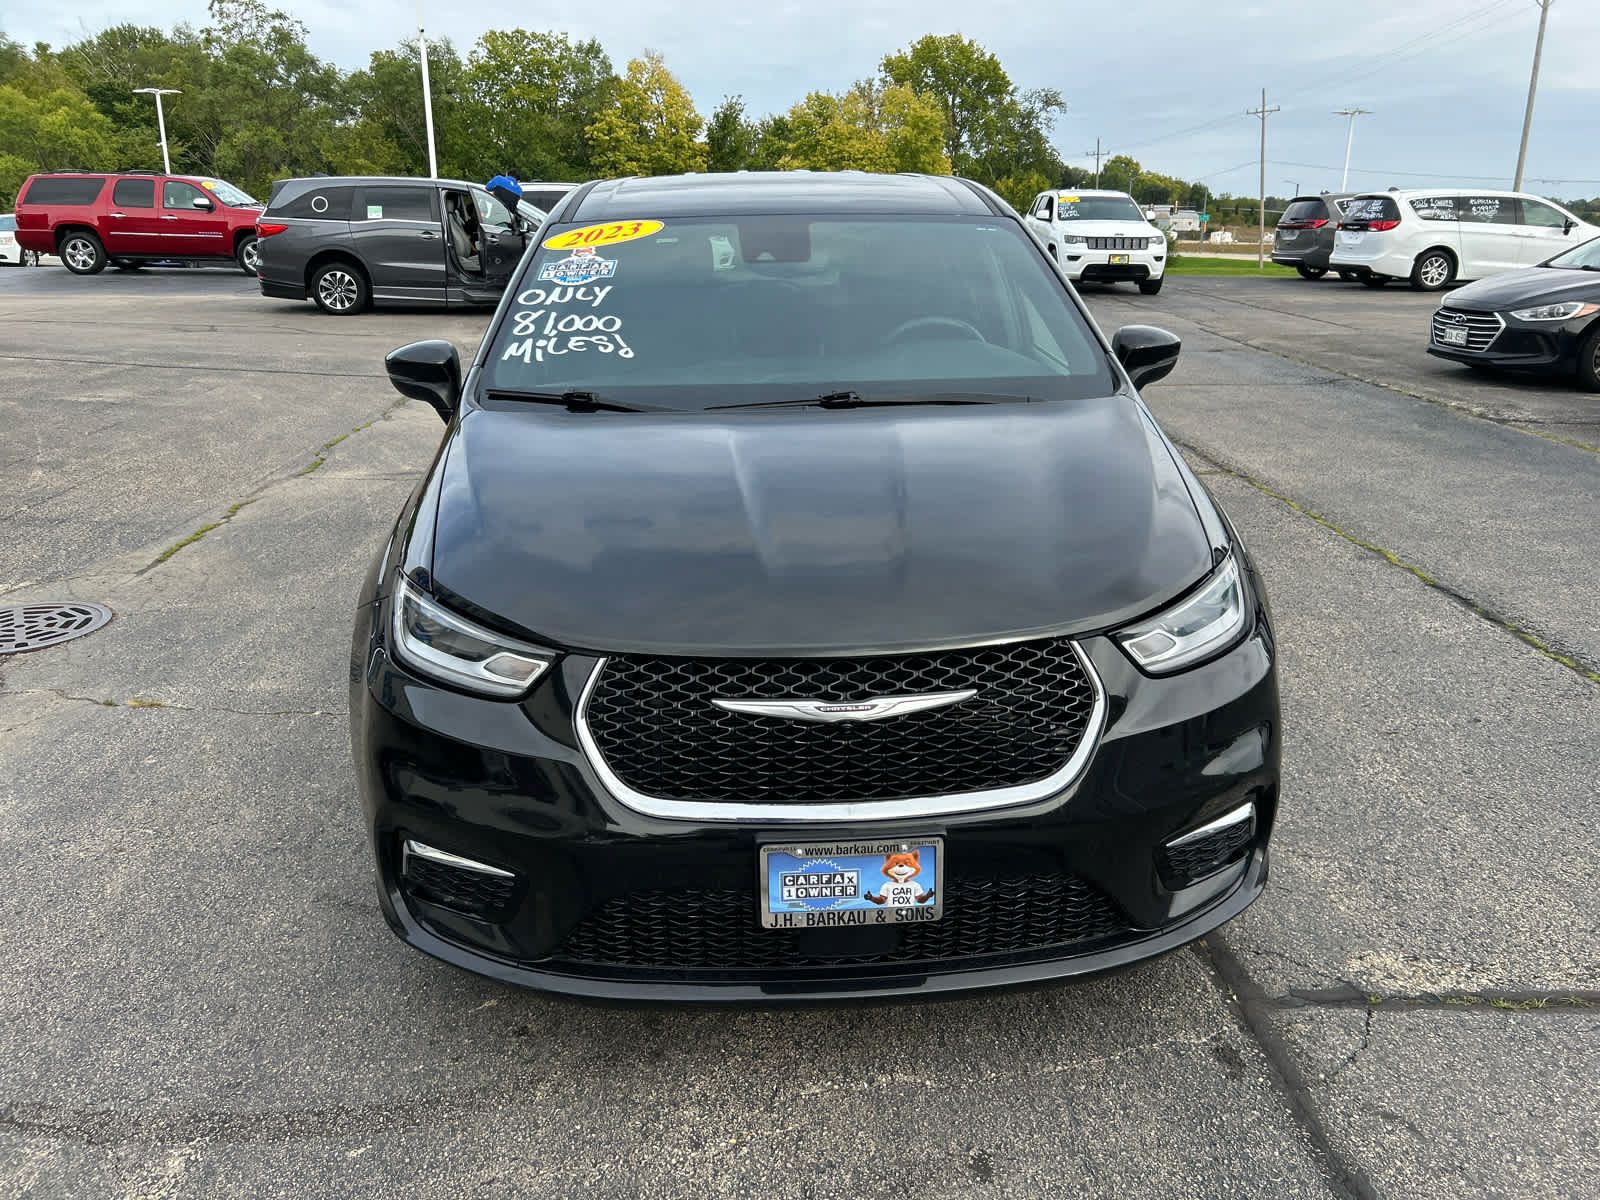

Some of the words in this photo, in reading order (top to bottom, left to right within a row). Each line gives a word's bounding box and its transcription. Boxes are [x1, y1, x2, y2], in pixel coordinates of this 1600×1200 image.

[562, 223, 642, 247] 2023
[547, 262, 613, 271] CARFAX
[517, 286, 614, 307] ONLY
[804, 842, 900, 857] www.barkau.com
[784, 874, 857, 887] CARFAX
[796, 885, 857, 898] OWNER
[892, 887, 912, 896] CAR
[892, 896, 911, 906] FOX
[770, 914, 798, 928] J.H.
[806, 911, 867, 927] BARKAU
[875, 910, 887, 923] &
[895, 906, 935, 921] SONS
